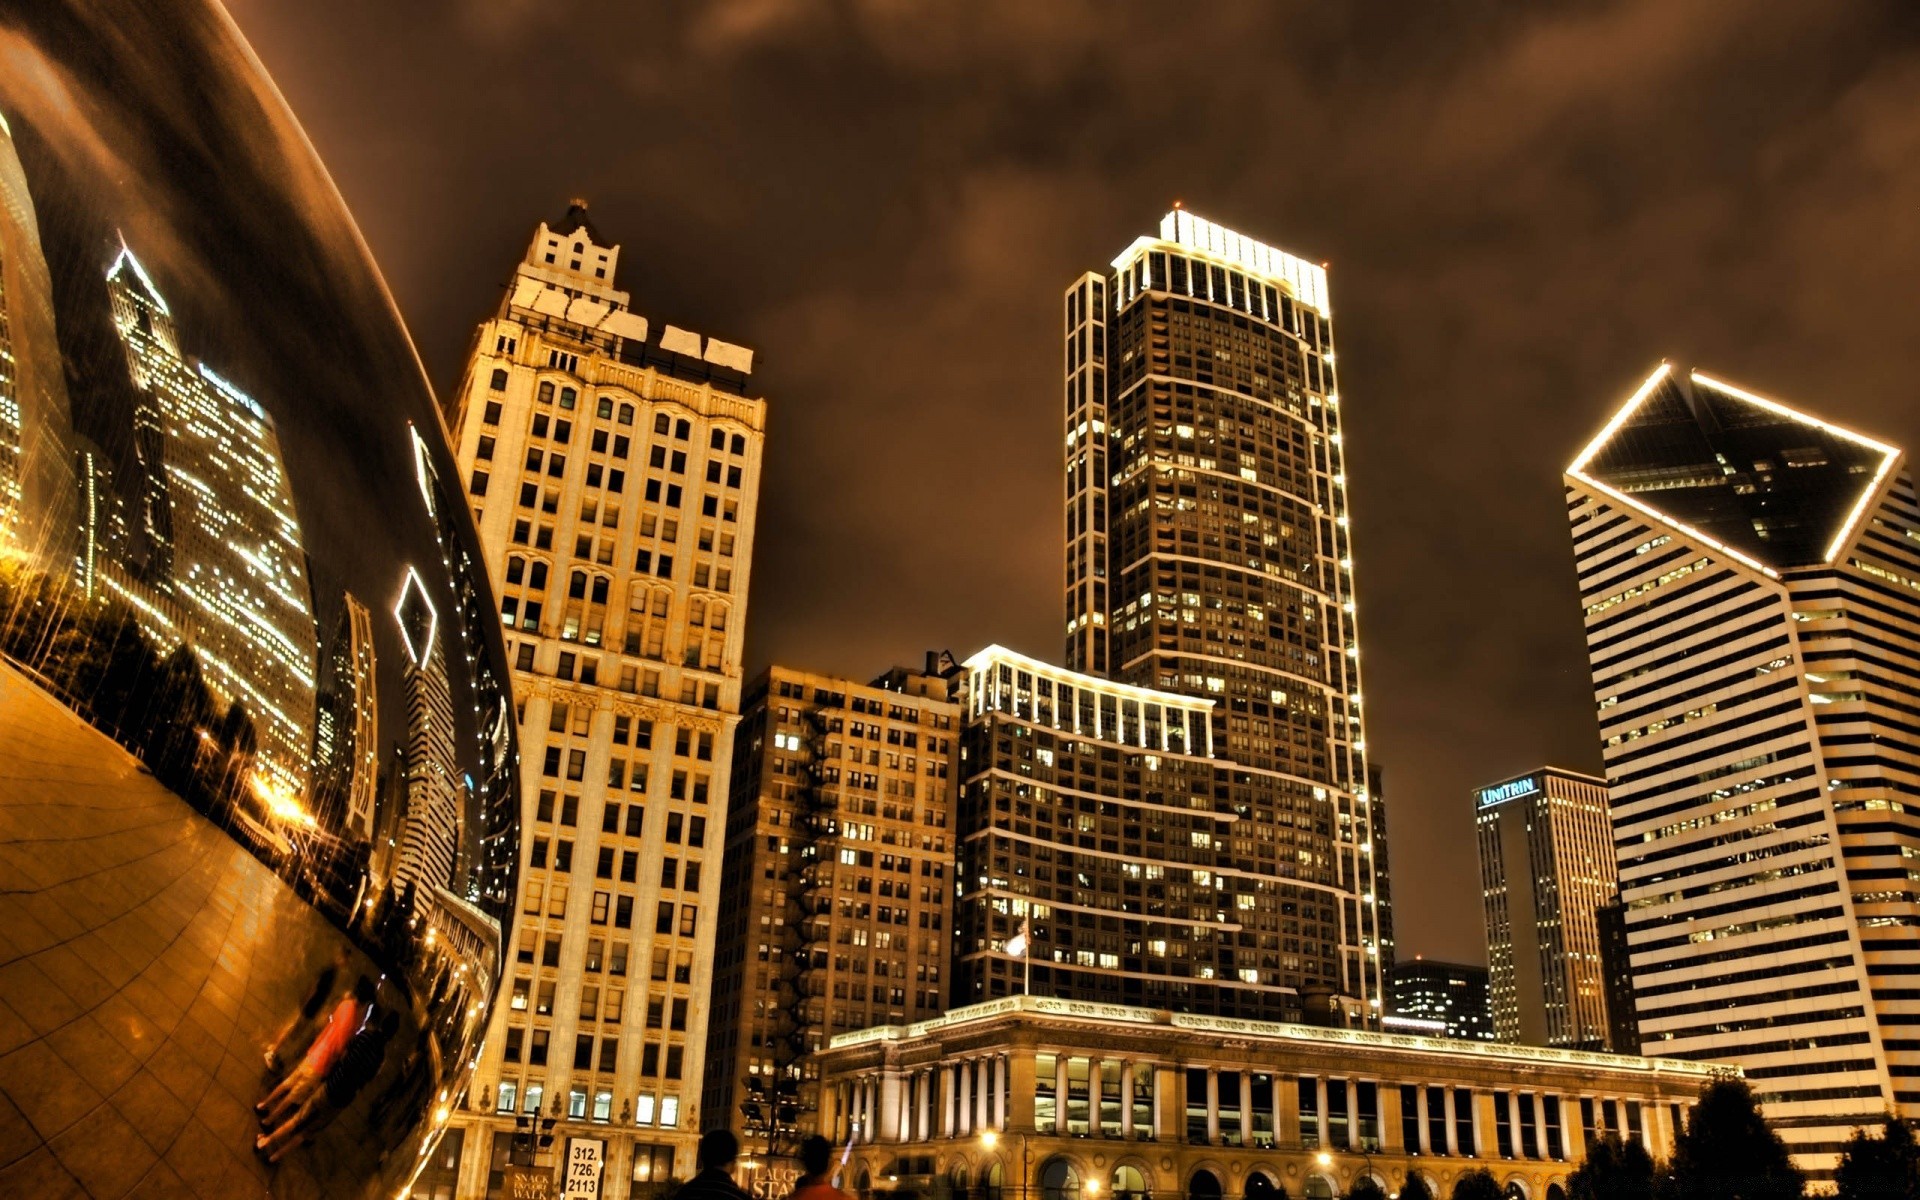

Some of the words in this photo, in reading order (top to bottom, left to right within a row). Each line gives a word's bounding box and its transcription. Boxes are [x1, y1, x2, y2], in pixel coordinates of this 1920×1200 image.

[1482, 778, 1534, 805] UNITRIN
[574, 1147, 597, 1161] 312.
[572, 1163, 595, 1176] 726.
[515, 1173, 549, 1184] SNACK
[568, 1179, 595, 1193] 2113
[513, 1189, 547, 1200] WALK
